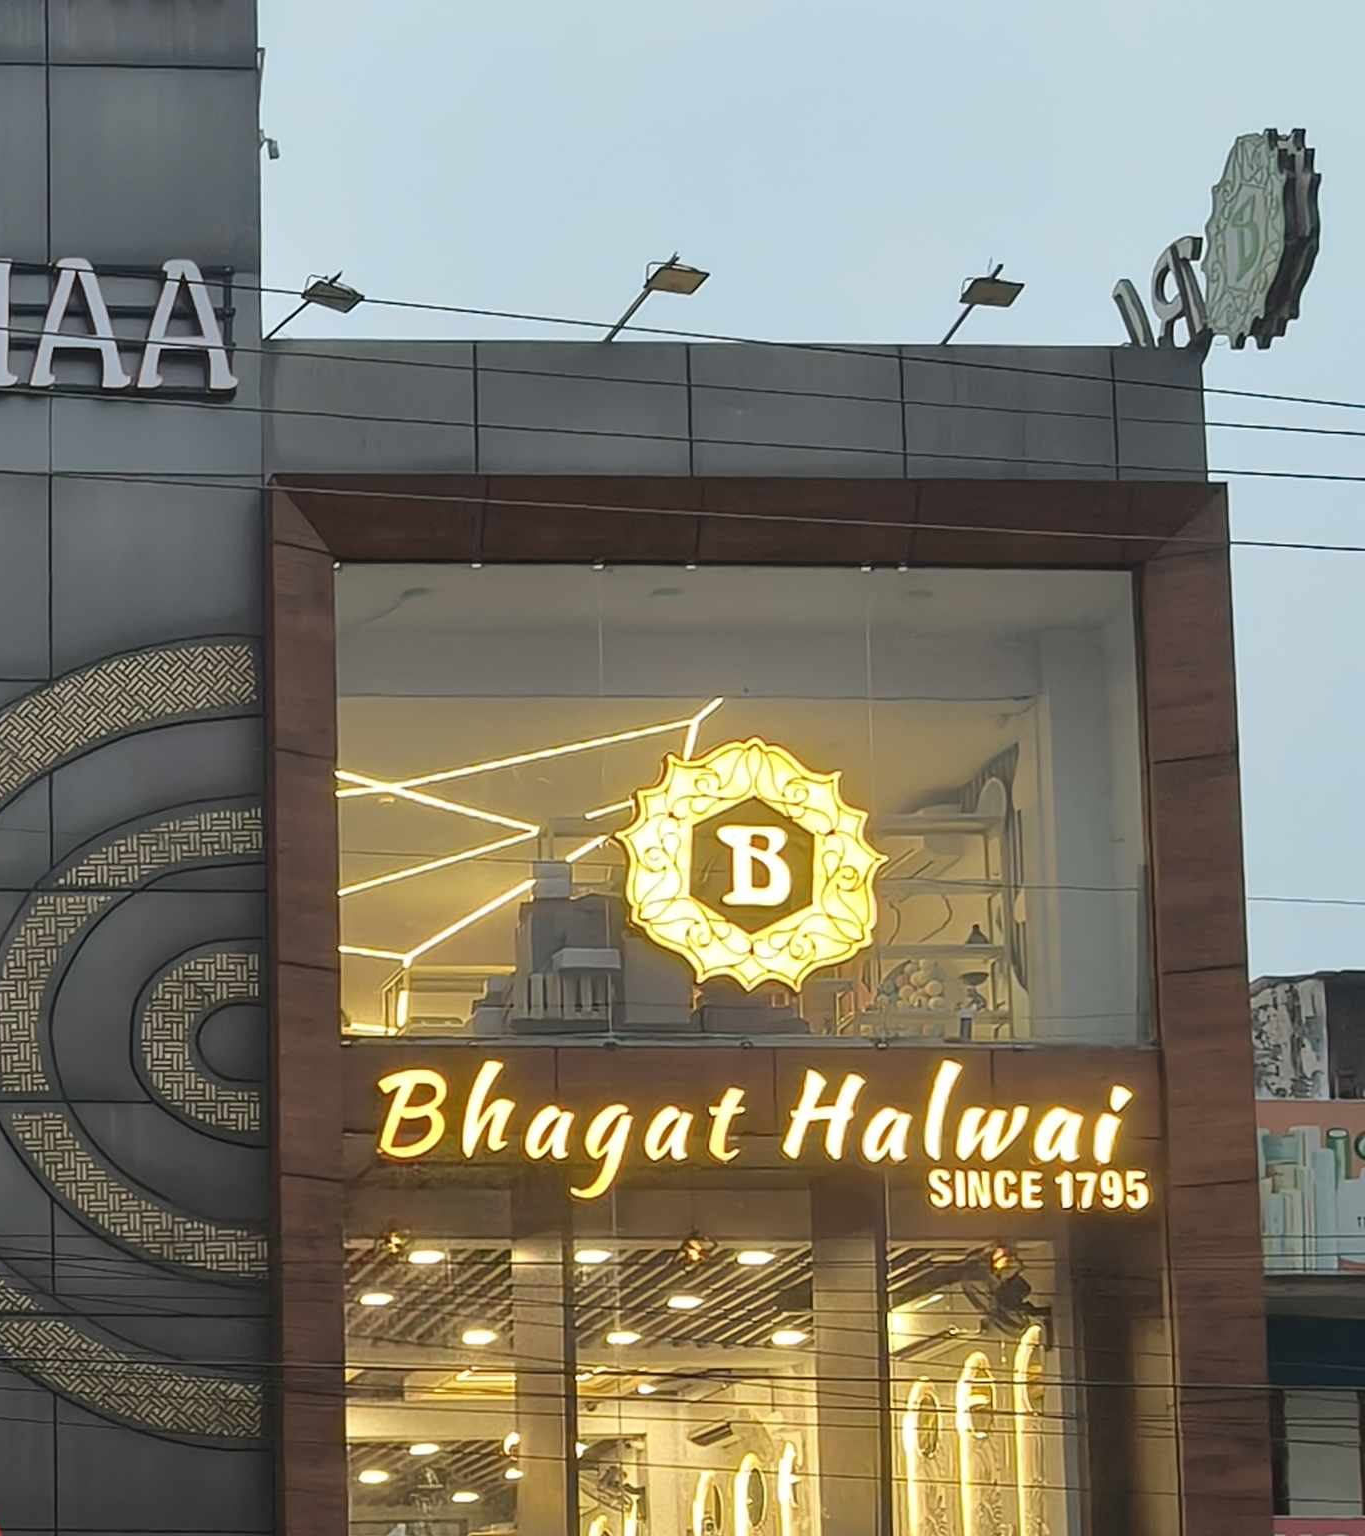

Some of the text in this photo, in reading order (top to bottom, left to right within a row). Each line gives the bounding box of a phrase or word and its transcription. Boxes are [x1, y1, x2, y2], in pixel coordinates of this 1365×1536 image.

[717, 823, 793, 907] B
[375, 1058, 1135, 1200] Bhagat Halwai
[929, 1168, 1151, 1212] SINCE 1795
